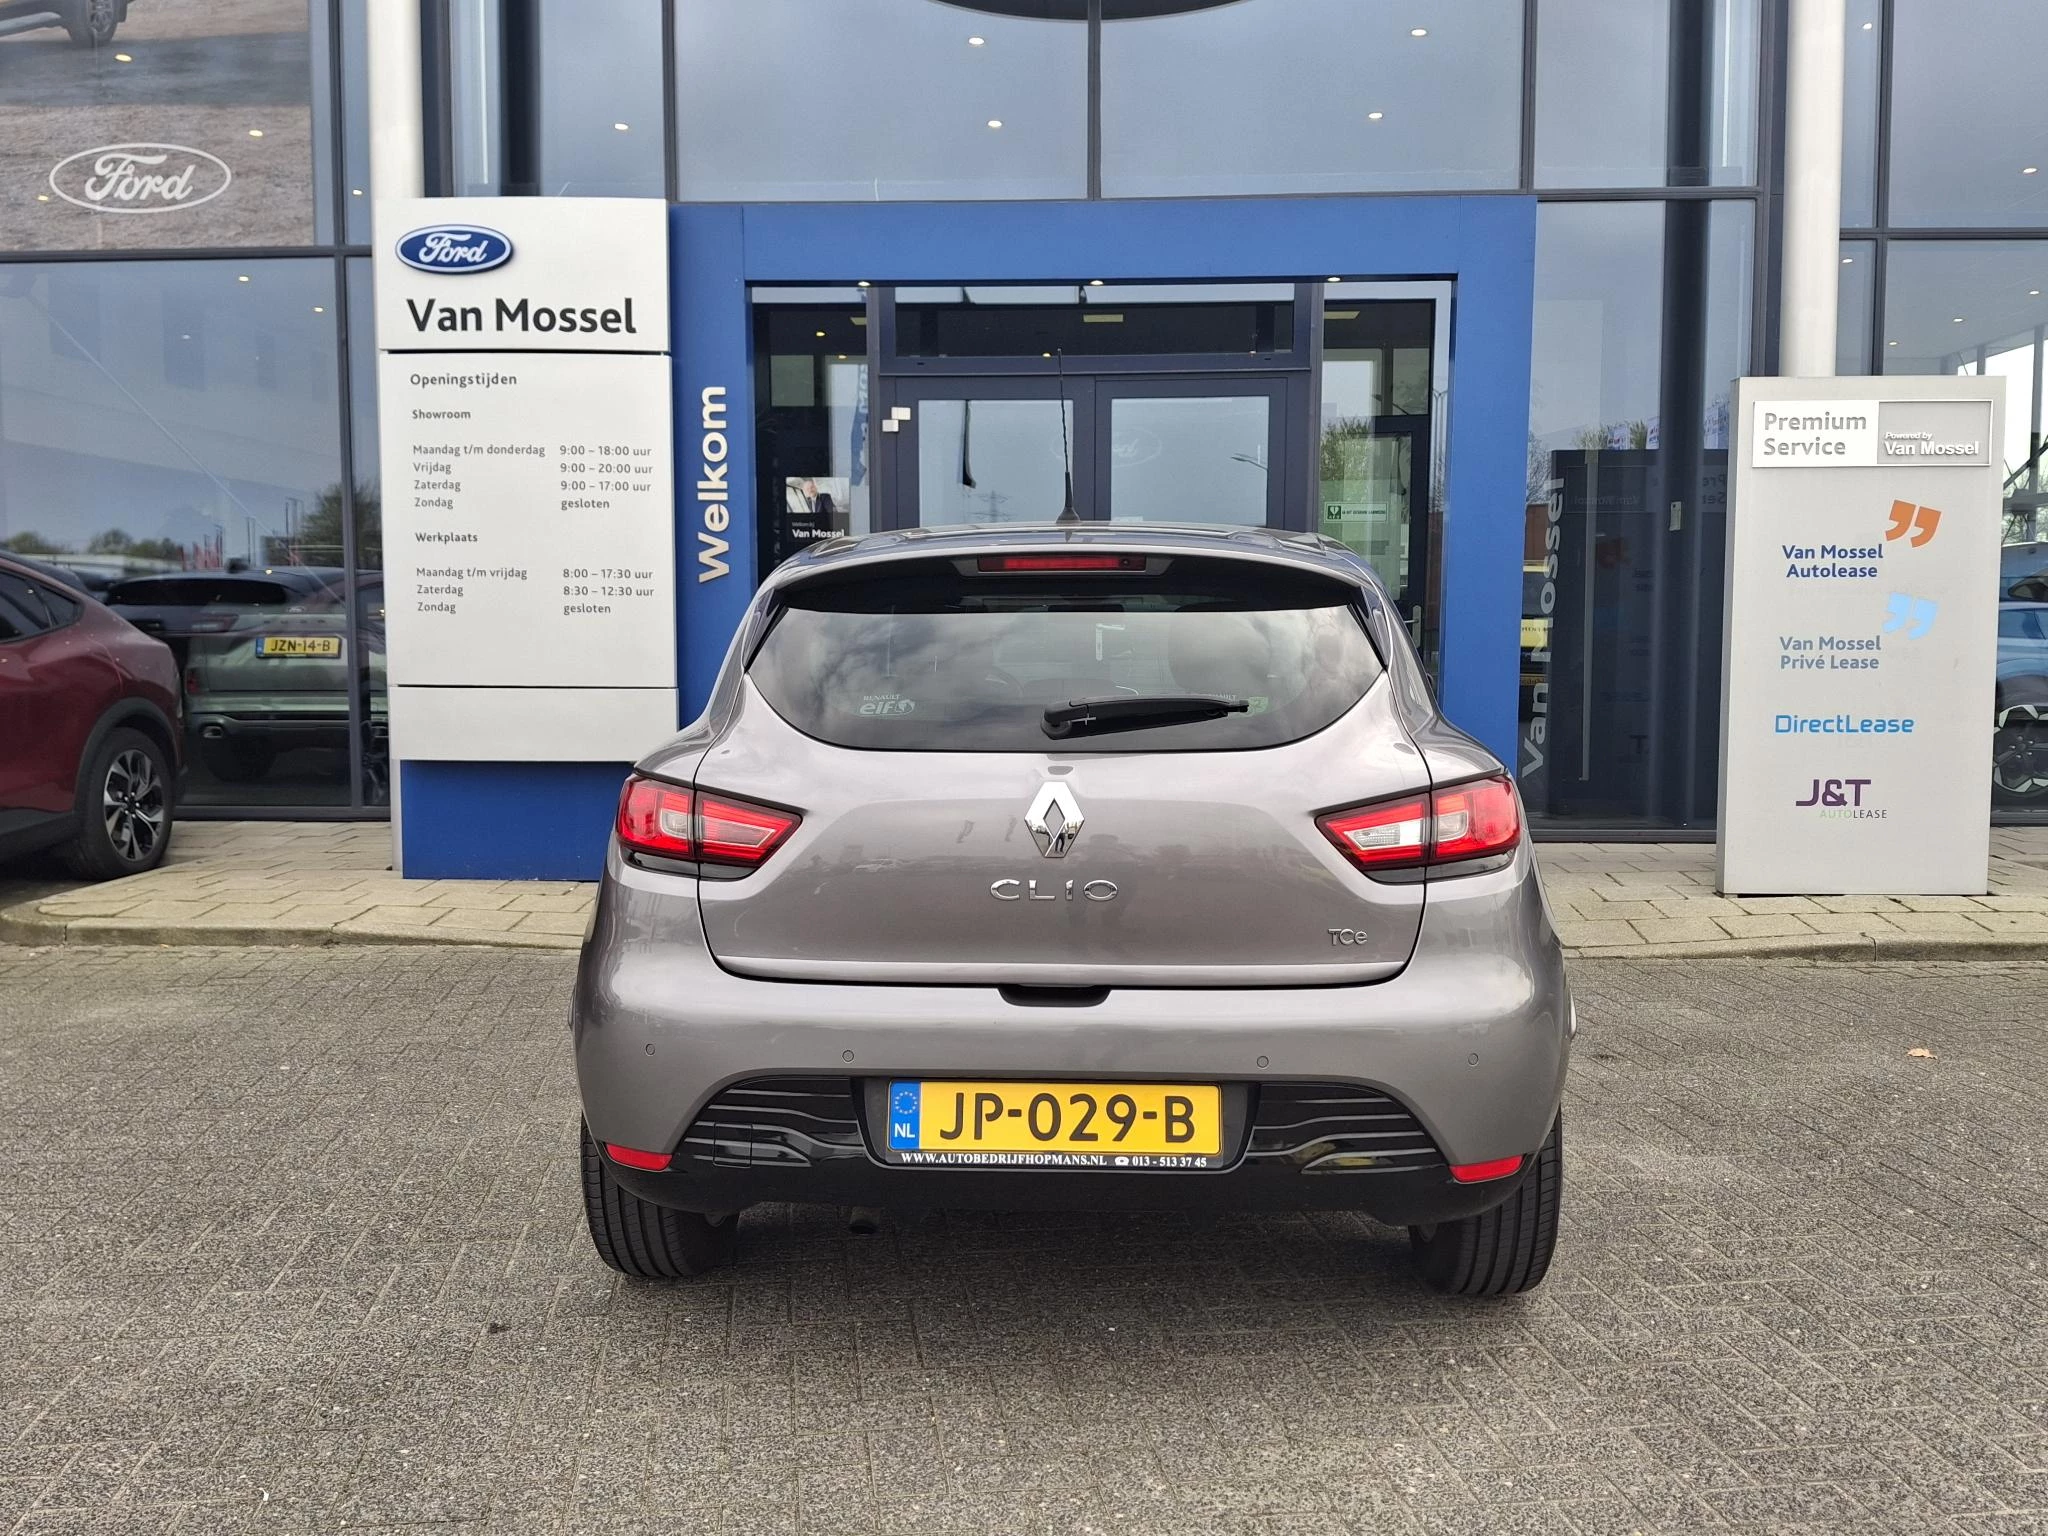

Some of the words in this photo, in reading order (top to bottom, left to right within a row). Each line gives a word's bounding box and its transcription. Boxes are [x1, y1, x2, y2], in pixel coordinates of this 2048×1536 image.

[85, 153, 196, 201] Ford
[419, 232, 488, 263] Ford
[407, 299, 482, 331] Van
[496, 298, 636, 333] Mossel
[411, 373, 516, 388] Openingstijden
[413, 409, 470, 419] Showroom
[1765, 412, 1866, 430] Premium
[1884, 432, 1921, 440] Powered
[1921, 432, 1933, 442] by
[414, 445, 460, 456] Maandag
[464, 445, 483, 454] t/m
[487, 445, 545, 457] donderdag
[560, 445, 584, 455] 9:00
[599, 446, 629, 455] 18:00
[1764, 437, 1845, 455] Service
[1884, 441, 1916, 456] Van
[1920, 441, 1980, 456] Mossel
[414, 463, 451, 474] Vrijdag
[560, 463, 585, 472] 9:00
[599, 464, 630, 473] 20:00
[415, 480, 460, 492] Zaterdag
[561, 481, 585, 490] 9:00
[599, 481, 629, 491] 17:00
[698, 387, 730, 583] Welkom
[415, 497, 453, 509] Zondag
[562, 499, 609, 510] gesloten
[416, 532, 477, 544] Werkplaats
[791, 528, 811, 539] Van
[811, 528, 845, 539] Mossel
[1782, 545, 1815, 559] Van
[1821, 544, 1883, 558] Mossel
[417, 568, 463, 579] Maandag
[467, 568, 486, 577] t/m
[490, 568, 527, 580] vrijdag
[563, 569, 588, 577] 8:00
[601, 569, 630, 578] 17:30
[1786, 563, 1877, 577] Autolease
[417, 585, 463, 596] Zaterdag
[564, 586, 588, 595] 8:30
[602, 587, 632, 596] 12:30
[418, 602, 456, 614] Zondag
[564, 604, 610, 615] gesloten
[271, 640, 330, 652] JZN-14-B
[1780, 637, 1813, 650] Van
[1819, 635, 1881, 650] Mossel
[1781, 655, 1825, 669] Privé
[1831, 655, 1879, 669] Lease
[1522, 682, 1549, 778] Van
[1776, 715, 1914, 732] DirectLease
[1796, 779, 1871, 806] J&T
[1819, 809, 1889, 820] AUTOLEASE
[990, 879, 1118, 901] CLIO
[1328, 928, 1367, 946] TCe
[939, 1092, 1196, 1143] JP-029-B
[894, 1122, 916, 1139] NL
[901, 1152, 1107, 1166] WWW.AUTOBEDRIJFHOPMANS.NL
[1132, 1155, 1151, 1167] 013
[1159, 1155, 1178, 1167] 513
[1179, 1155, 1193, 1167] 37
[1194, 1156, 1208, 1168] 45
